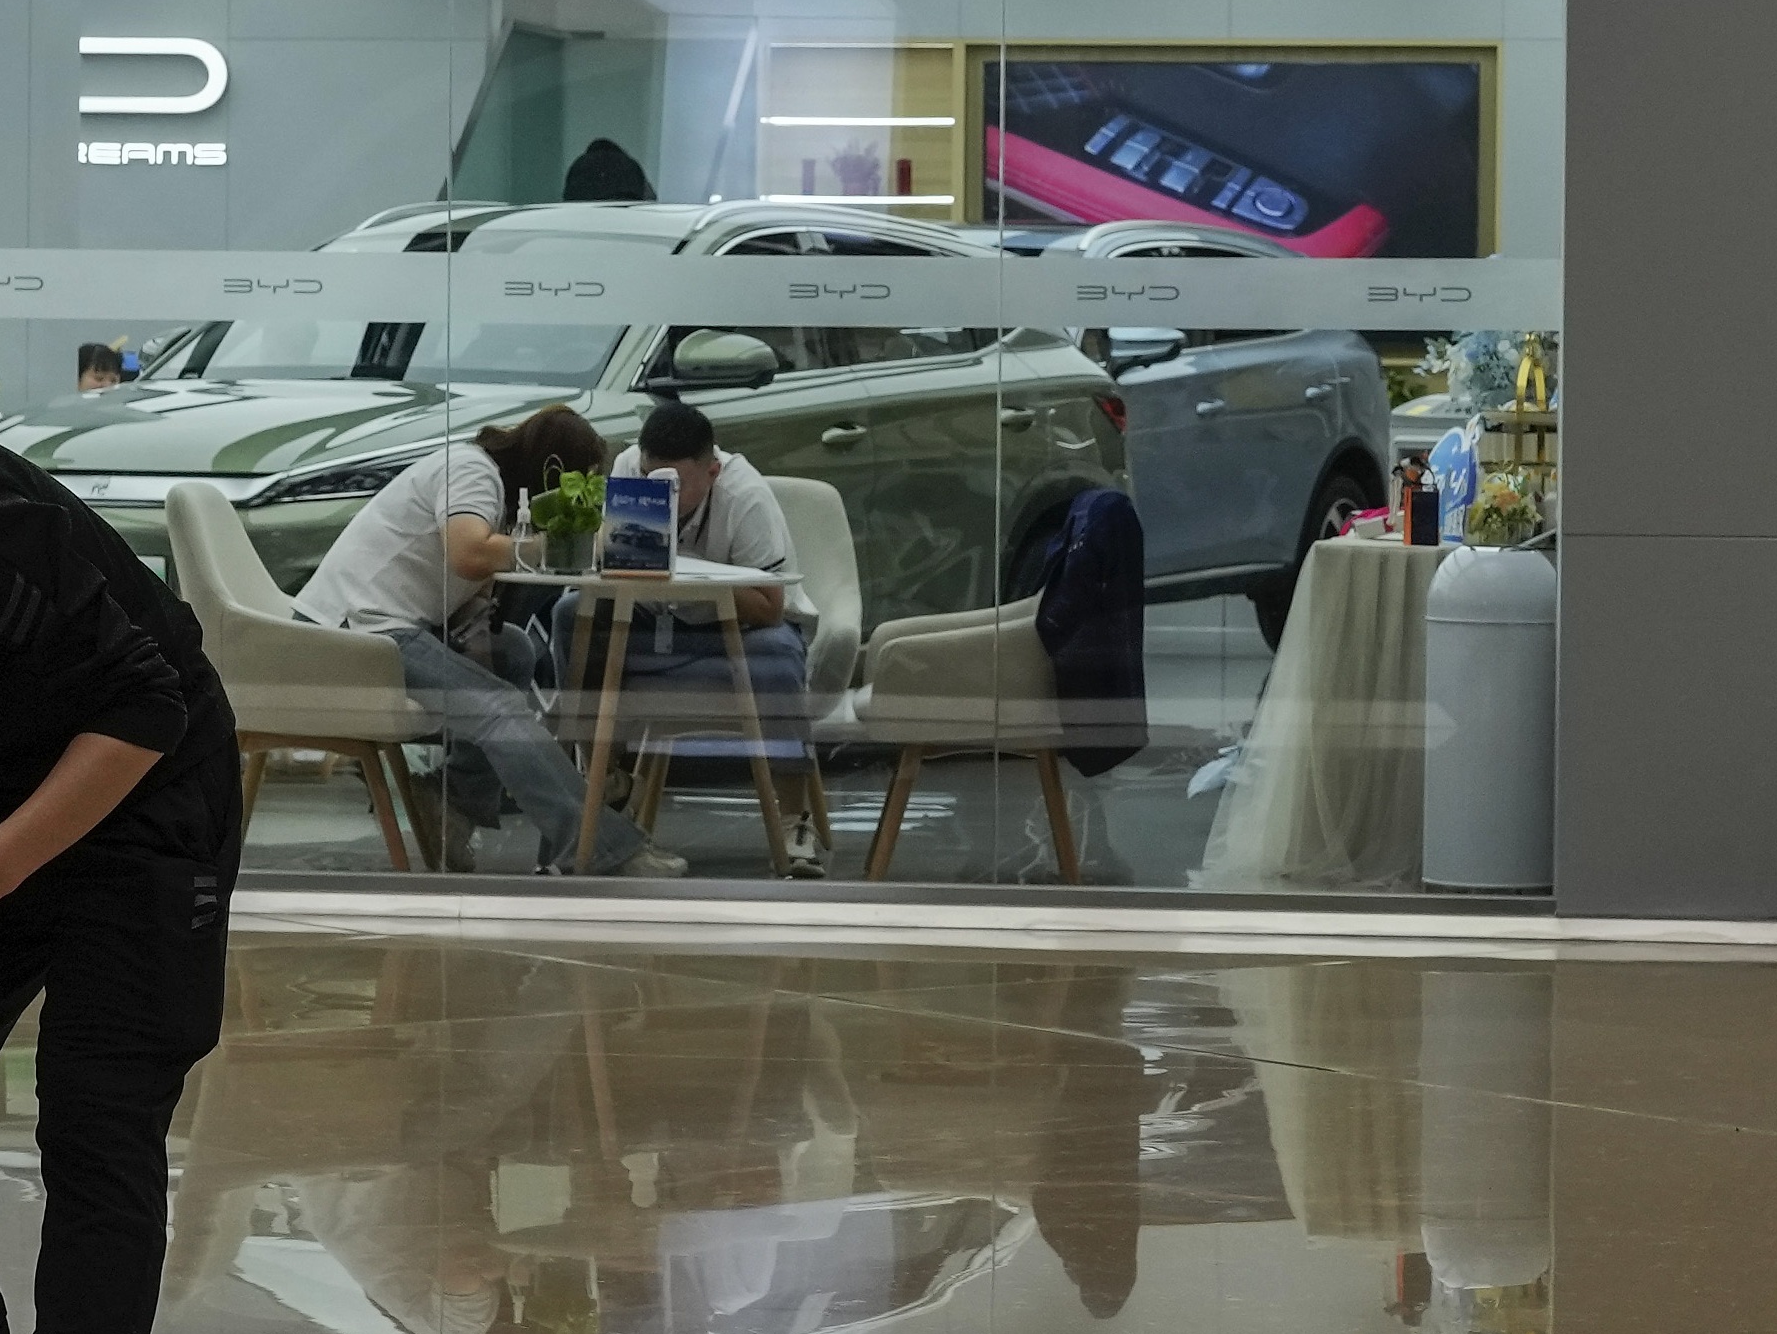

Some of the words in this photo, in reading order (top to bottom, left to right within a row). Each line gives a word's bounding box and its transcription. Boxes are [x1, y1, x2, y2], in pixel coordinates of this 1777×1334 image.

[78, 141, 228, 166] EAMS
[223, 277, 323, 294] BYD
[503, 280, 605, 297] BYD
[788, 283, 891, 299] BYD
[1075, 284, 1180, 302] BYD
[1367, 286, 1472, 303] BYD
